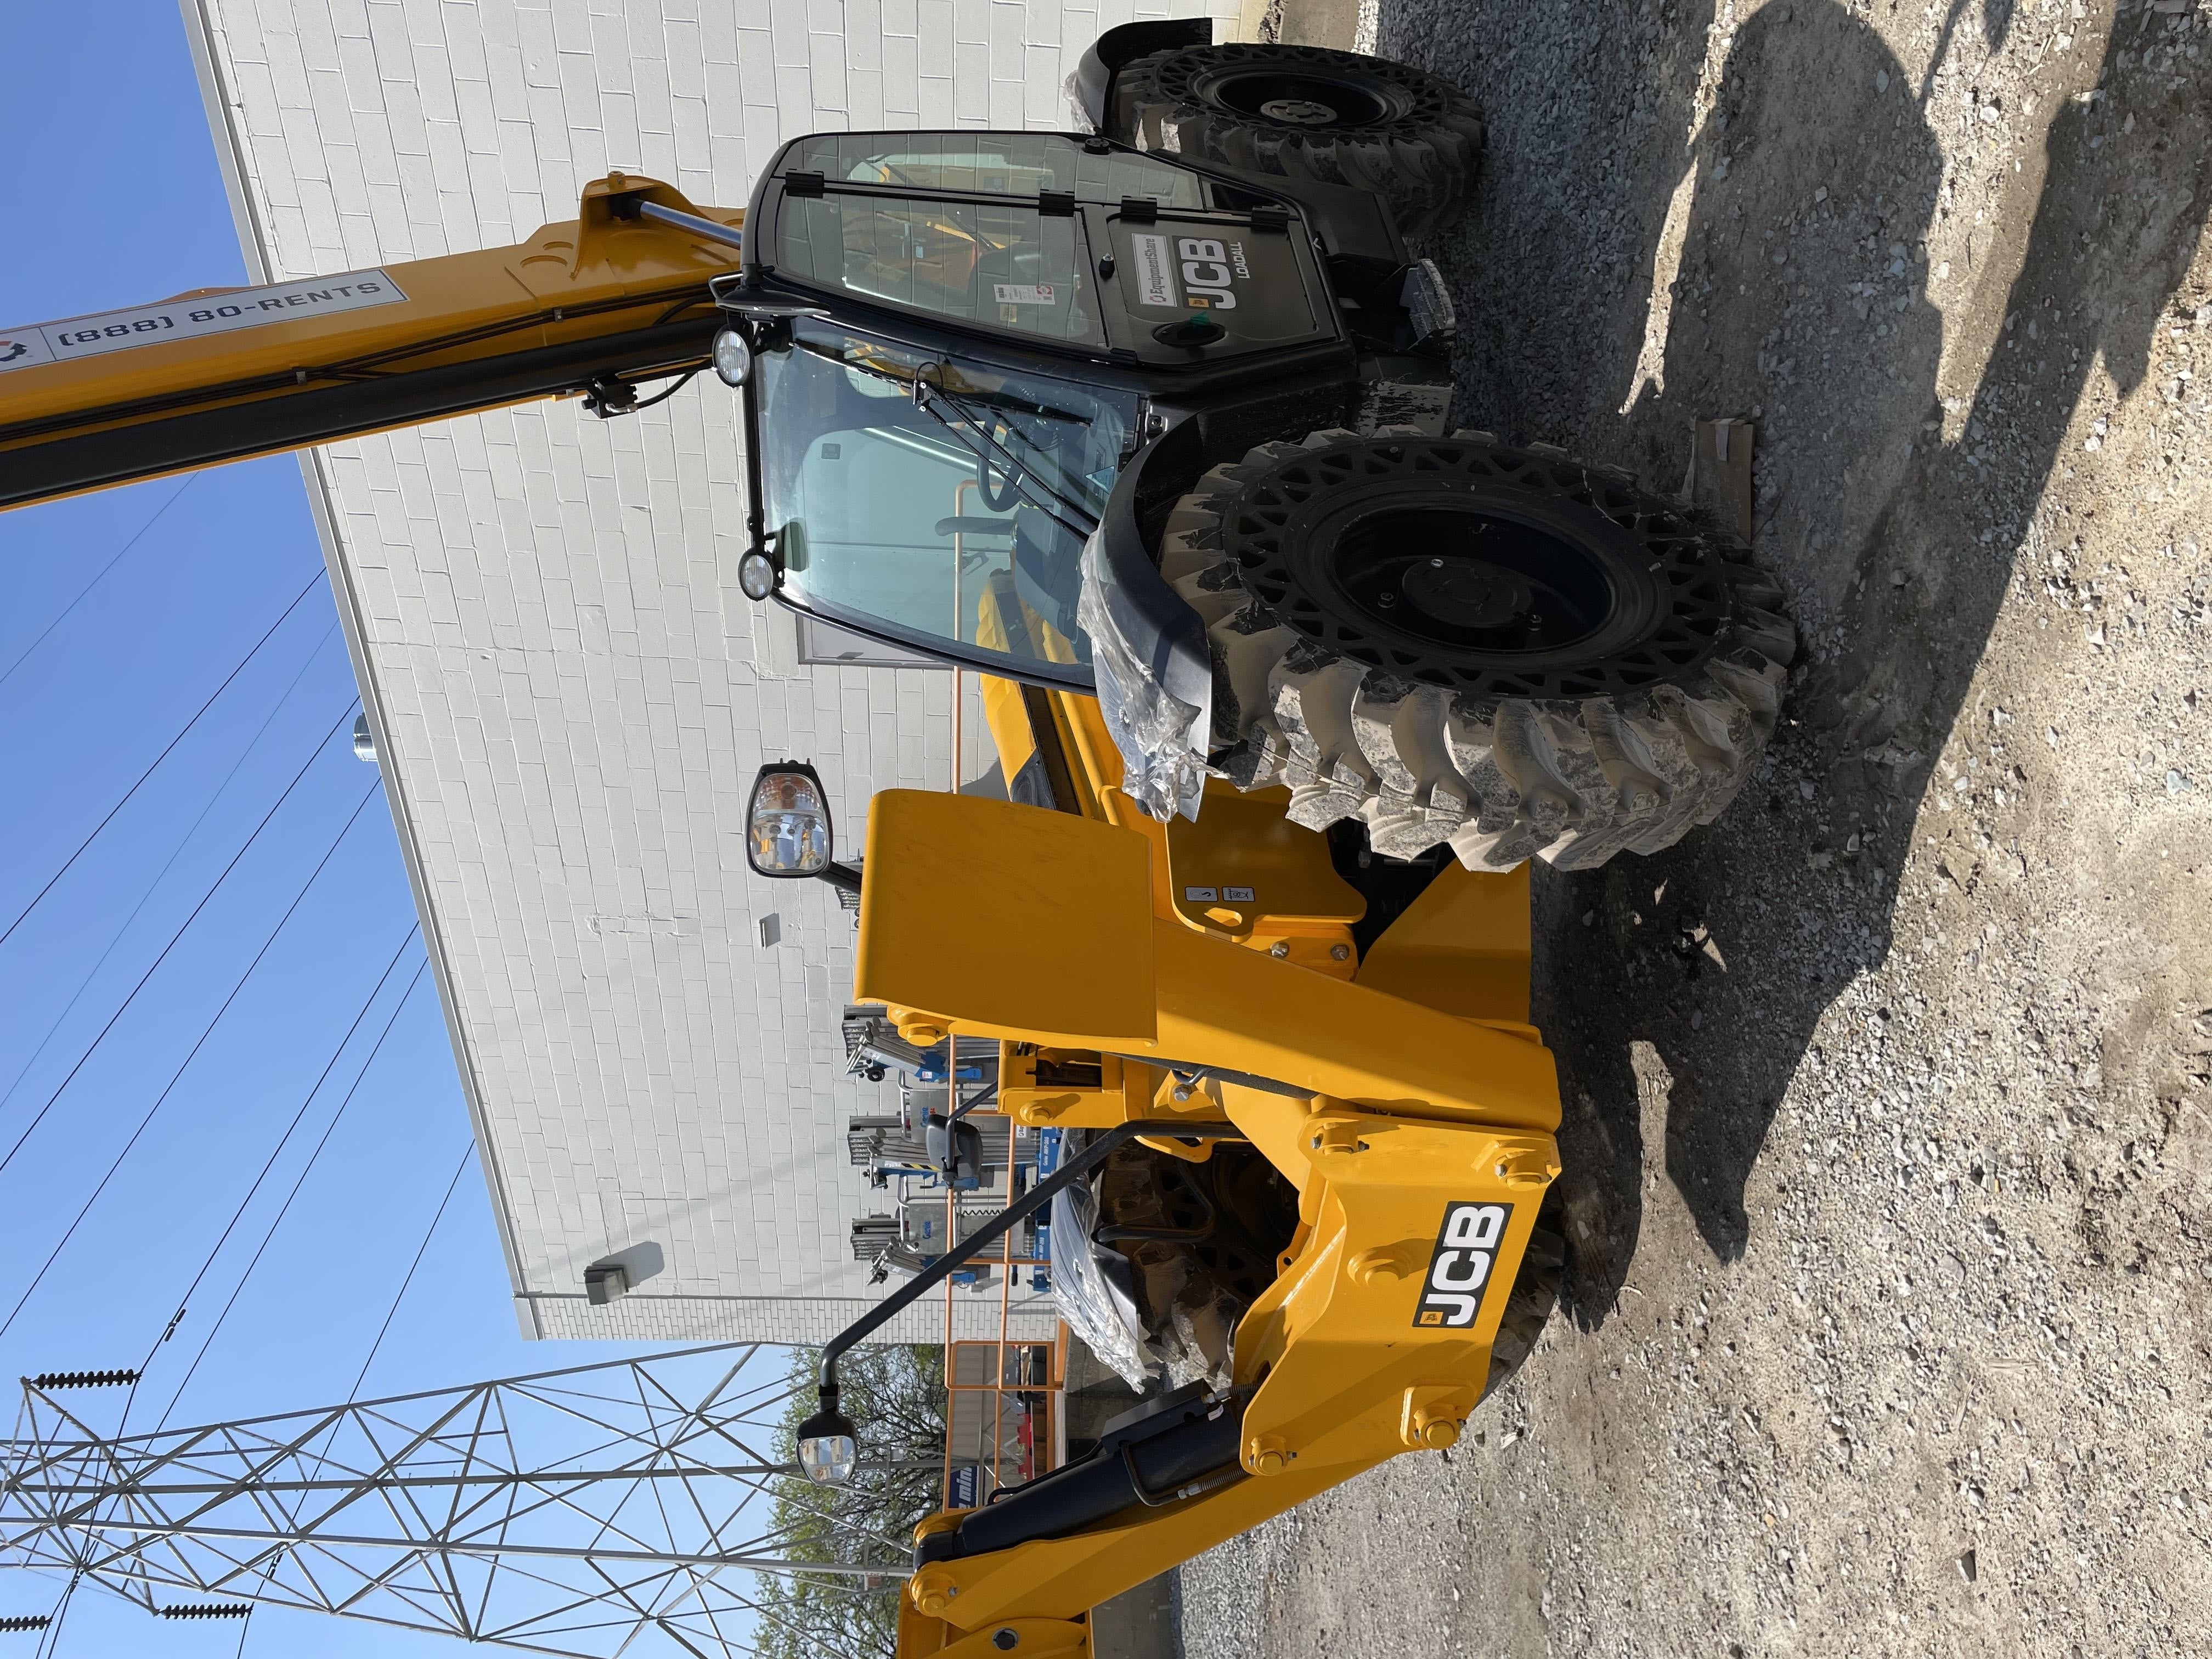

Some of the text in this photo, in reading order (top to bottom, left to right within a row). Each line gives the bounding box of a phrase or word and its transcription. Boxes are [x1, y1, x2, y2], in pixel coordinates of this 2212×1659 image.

[1144, 238, 1166, 295] EquipmentShare
[1178, 239, 1236, 309] JCB
[1230, 242, 1250, 279] LOADALL
[58, 283, 381, 346] (888) 80-RENTS
[922, 1221, 931, 1239] Genie
[1425, 1206, 1505, 1325] JCB
